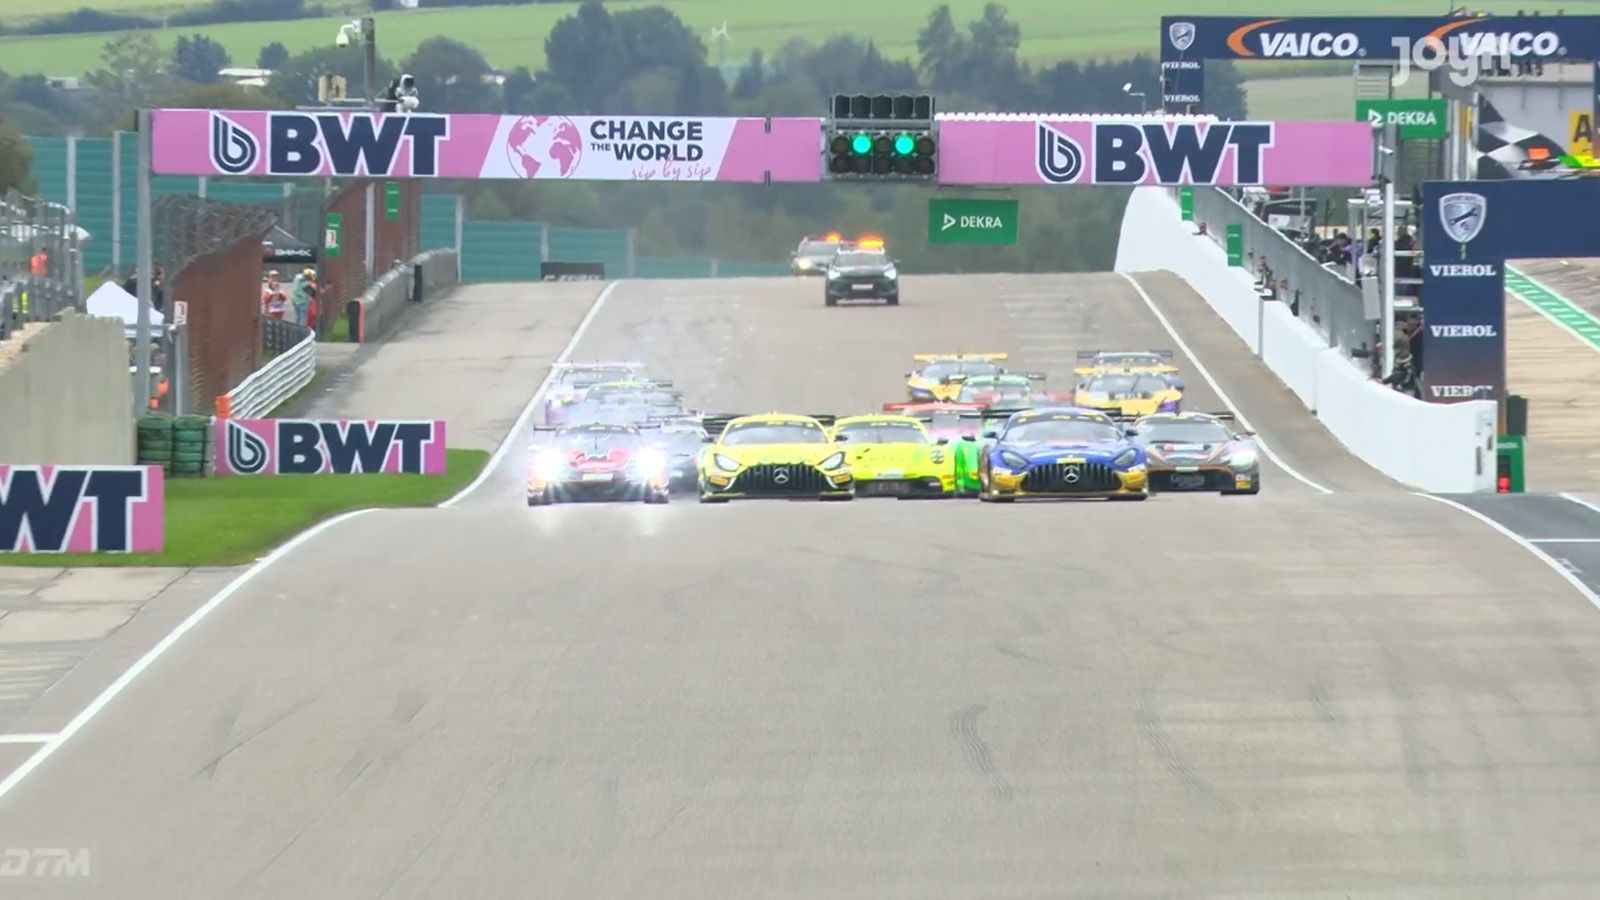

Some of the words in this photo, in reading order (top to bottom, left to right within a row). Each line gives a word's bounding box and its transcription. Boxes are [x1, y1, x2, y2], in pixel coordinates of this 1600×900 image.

[1260, 32, 1359, 57] VAICO
[1387, 111, 1437, 125] DEKRA
[590, 120, 703, 141] CHANGE
[269, 114, 448, 176] BWT
[590, 143, 611, 151] THE
[613, 143, 704, 161] WORLD
[1095, 123, 1272, 184] BWT
[631, 165, 657, 181] sip
[663, 153, 681, 182] by
[686, 163, 712, 181] sip
[960, 215, 1003, 228] DEKRA
[1430, 264, 1497, 277] VIEROL
[1430, 324, 1497, 337] VIEROL
[1431, 385, 1494, 397] VIER
[278, 421, 433, 475] BWT
[0, 470, 143, 552] WT
